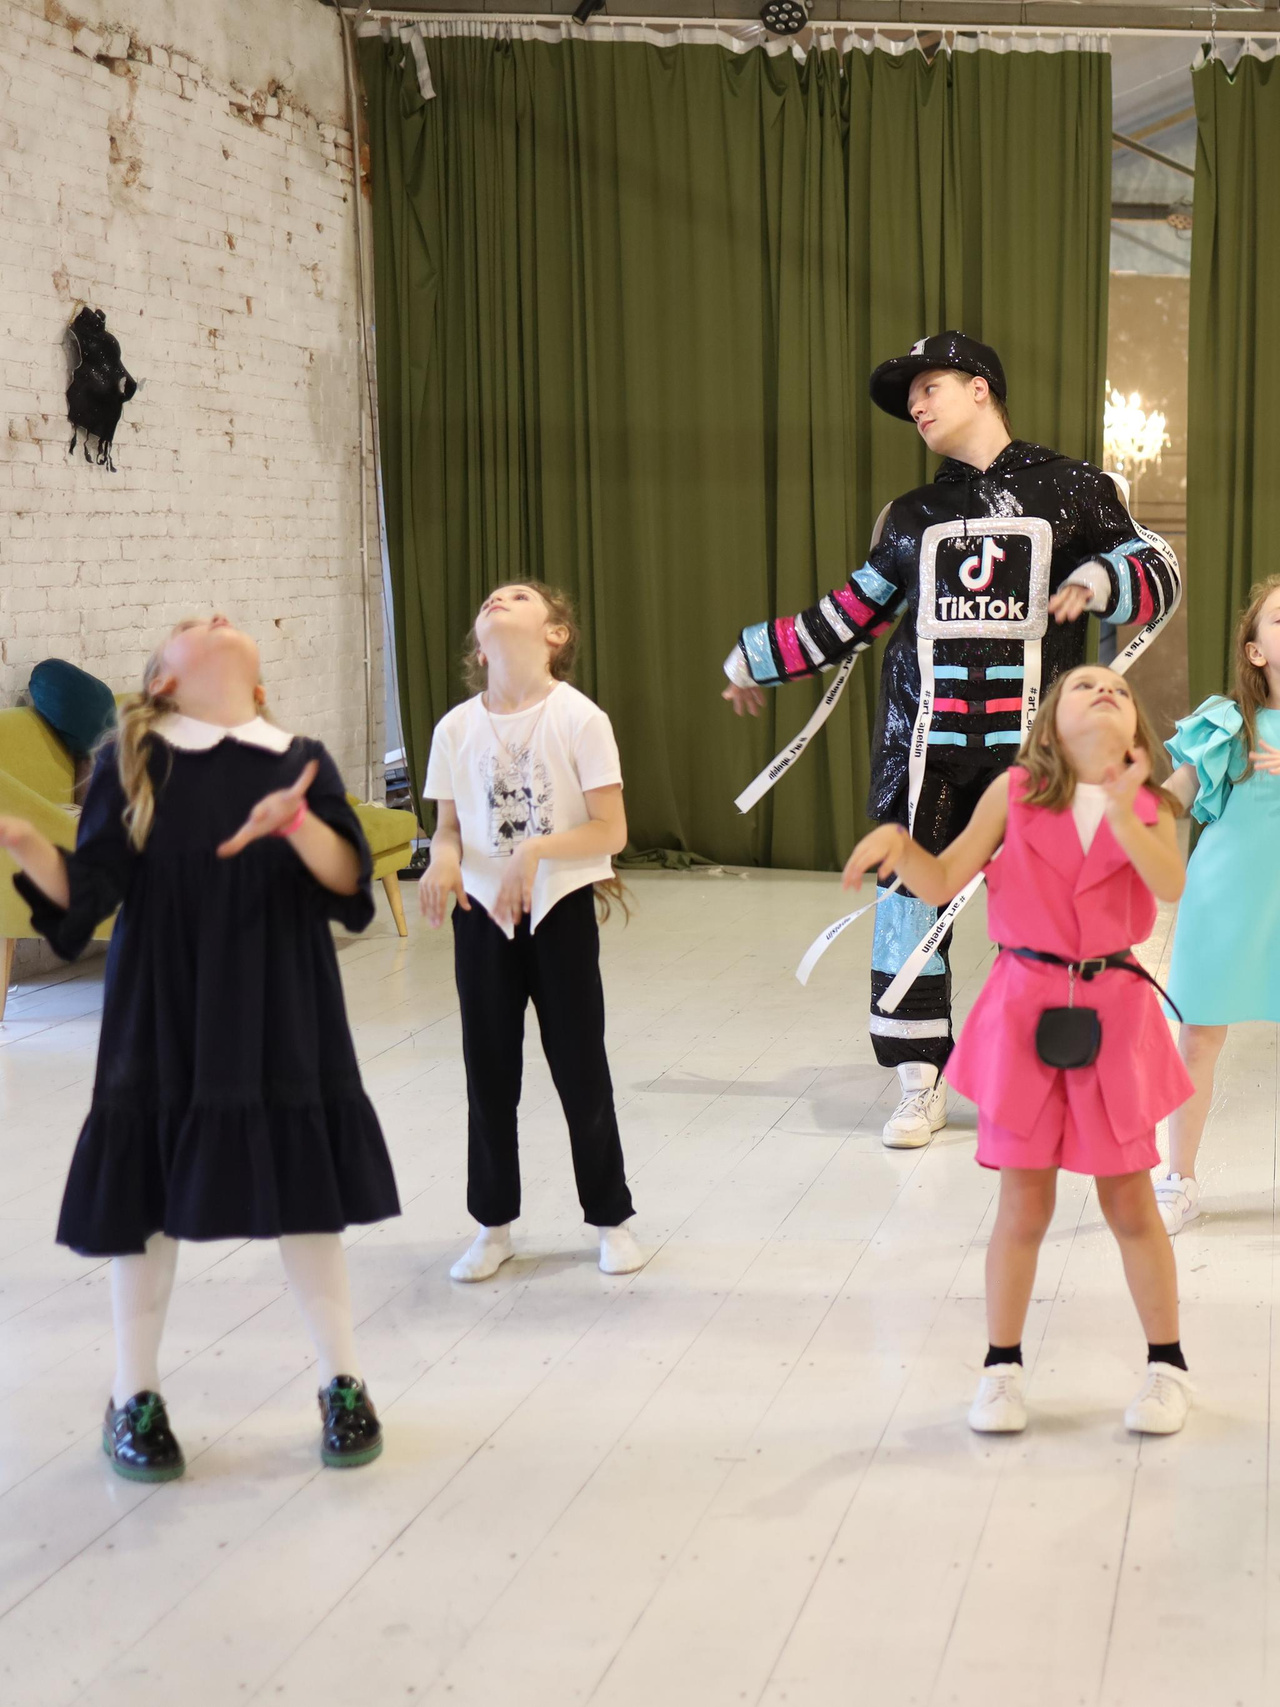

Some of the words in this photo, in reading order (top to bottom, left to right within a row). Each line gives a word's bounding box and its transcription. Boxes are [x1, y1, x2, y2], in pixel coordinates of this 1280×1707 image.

[938, 595, 1025, 621] TikTok
[914, 690, 932, 758] #art_apelsin
[1025, 687, 1038, 732] #art_ap
[922, 895, 966, 954] #art_apelsin
